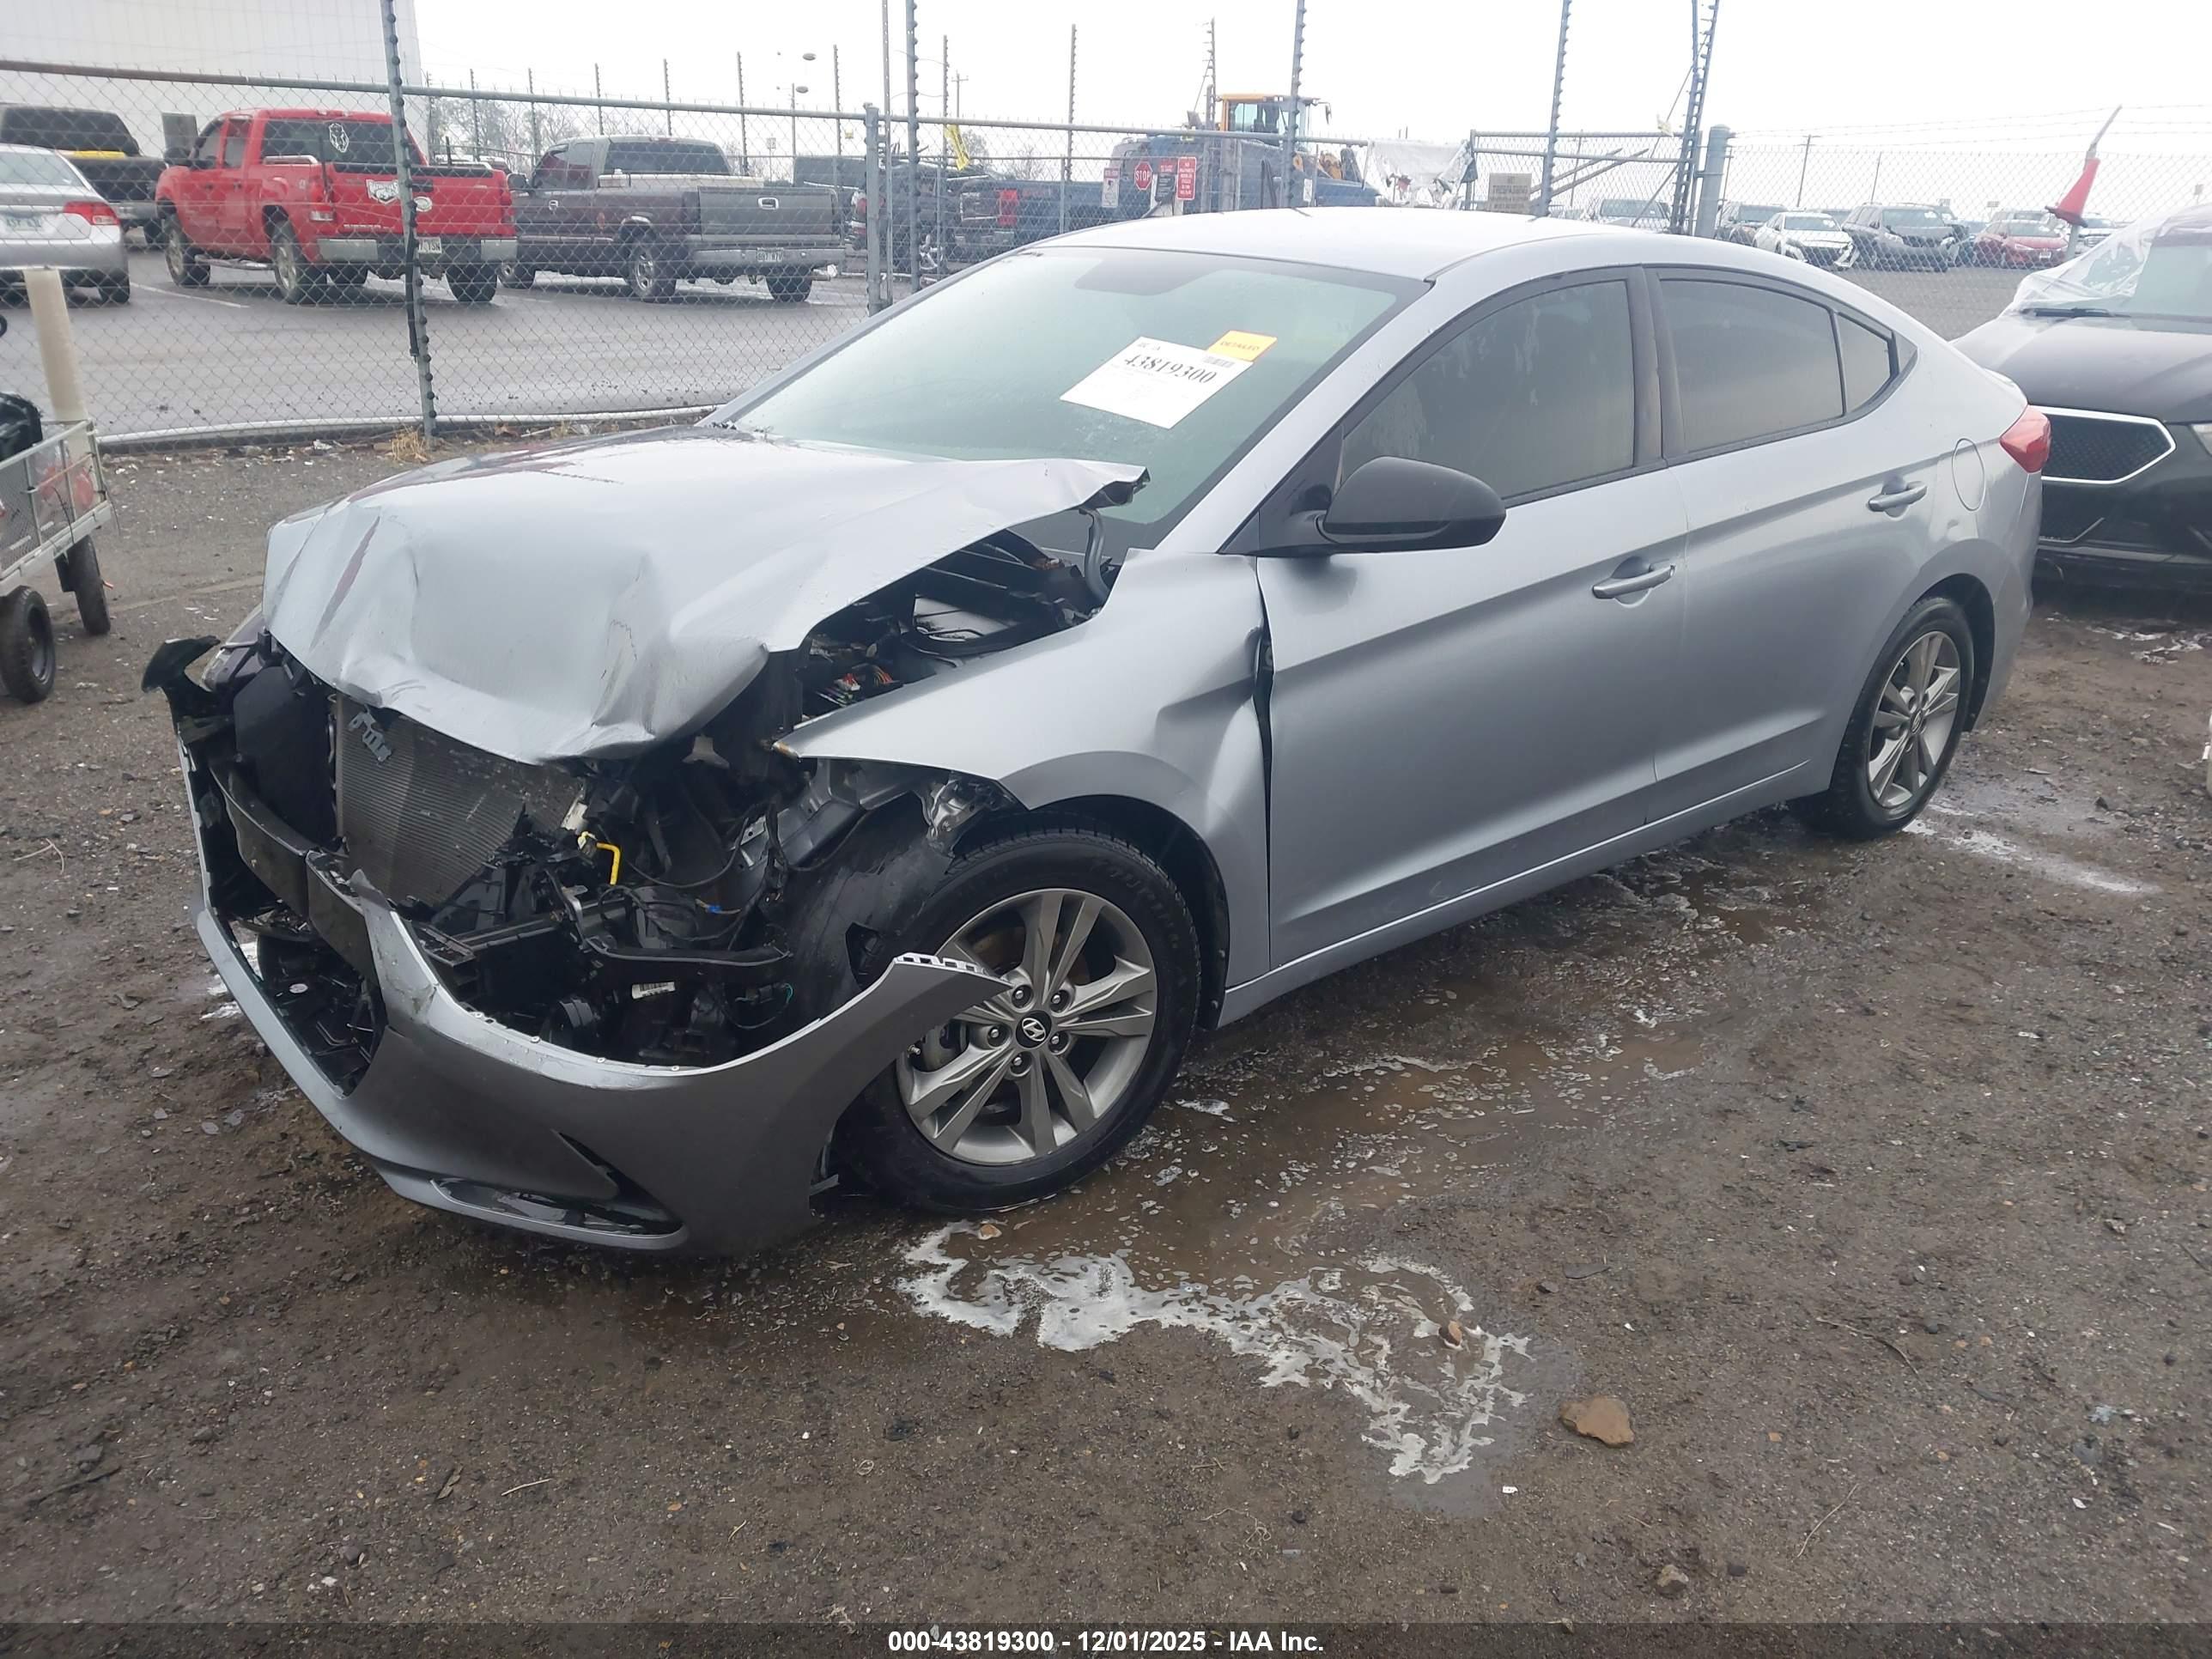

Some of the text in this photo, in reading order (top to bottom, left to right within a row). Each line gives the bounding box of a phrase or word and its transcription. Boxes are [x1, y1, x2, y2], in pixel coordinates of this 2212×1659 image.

[1135, 170, 1151, 181] STOP
[1219, 341, 1261, 351] DETAILED
[1124, 355, 1217, 383] 43819300
